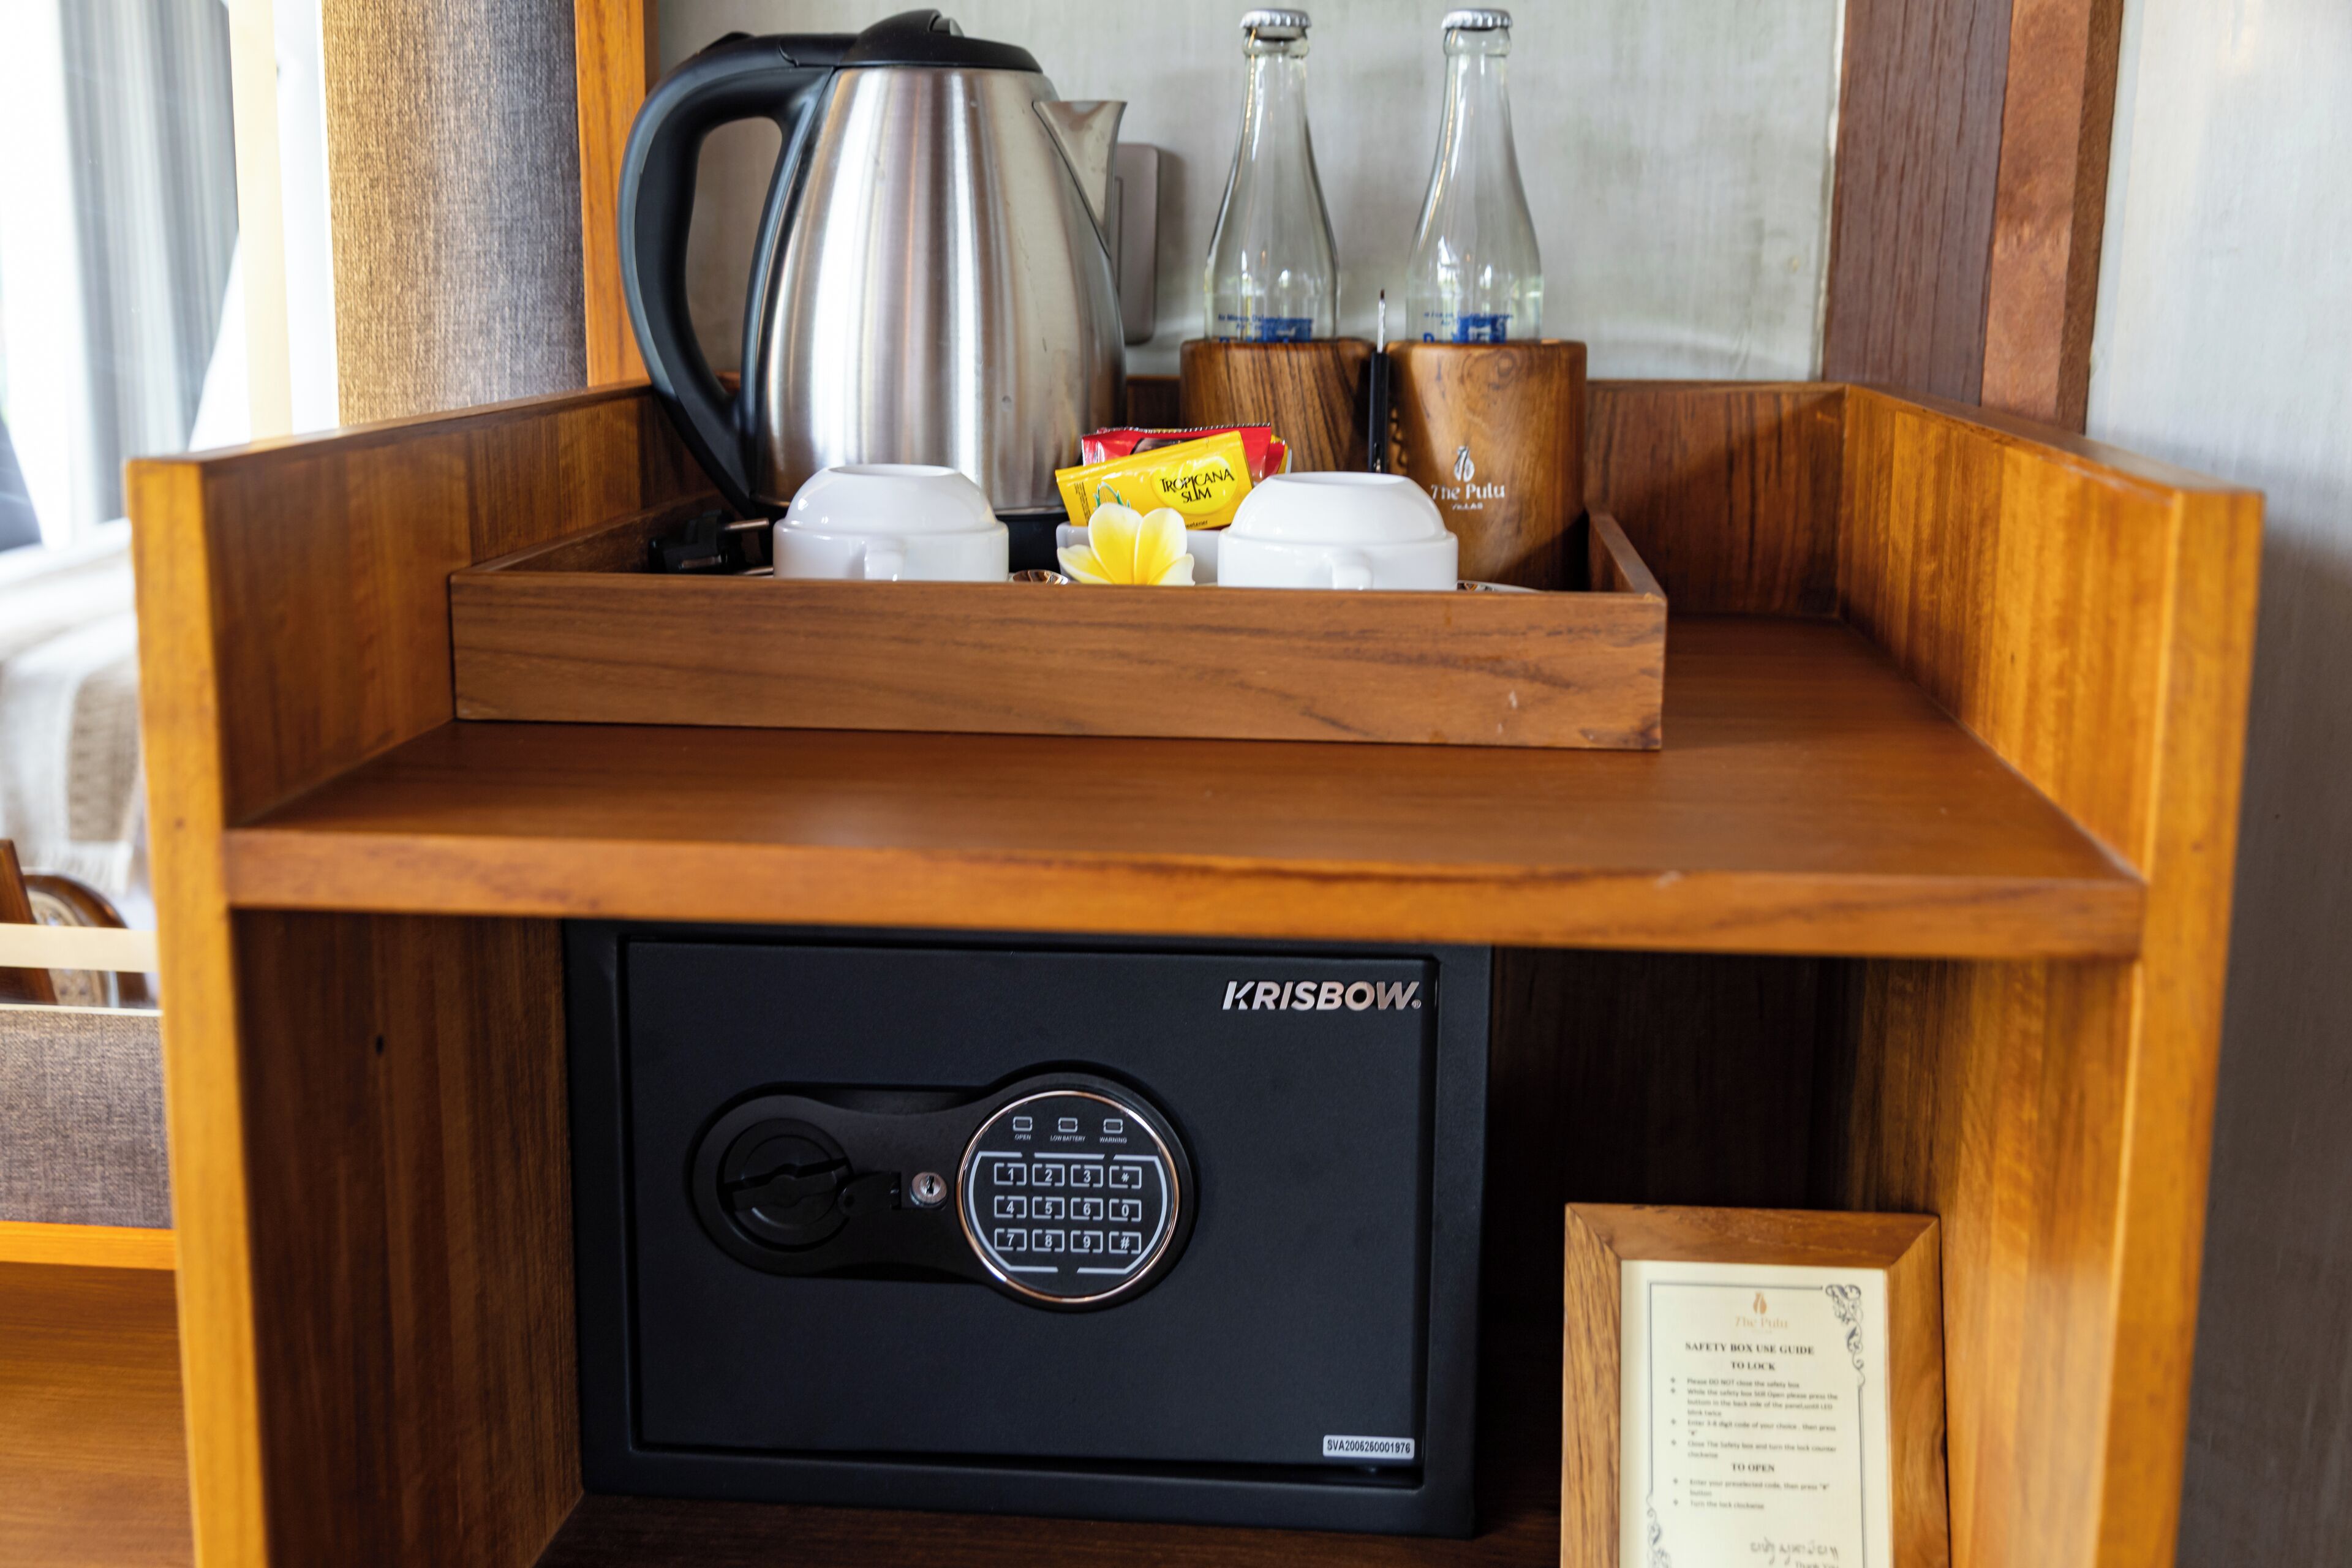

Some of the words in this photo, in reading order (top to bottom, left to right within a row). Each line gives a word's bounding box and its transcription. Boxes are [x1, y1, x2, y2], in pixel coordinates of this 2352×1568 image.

[1160, 468, 1235, 492] TROPICANA
[1182, 487, 1212, 503] SLIM
[1431, 484, 1461, 500] The
[1466, 482, 1505, 500] Pulu
[1222, 981, 1419, 1011] KRISBOW
[1008, 1167, 1014, 1181] 1
[1045, 1169, 1053, 1182] 2
[1084, 1170, 1091, 1183] 3
[1006, 1200, 1014, 1214] 4
[1045, 1201, 1053, 1215] 5
[1083, 1202, 1091, 1216] 6
[1121, 1204, 1129, 1217] 0
[1007, 1234, 1014, 1246] 7
[1045, 1234, 1053, 1248] 8
[1083, 1235, 1091, 1248] 9
[1735, 1316, 1756, 1327] The
[1762, 1316, 1789, 1329] Pulu
[1685, 1342, 1726, 1351] SAFETY
[1730, 1343, 1752, 1352] BOX
[1757, 1344, 1776, 1353] USE
[1779, 1344, 1814, 1354] GUIDE
[1747, 1362, 1776, 1370] LOCK
[1719, 1420, 1733, 1428] digit
[1748, 1464, 1776, 1472] OPEN
